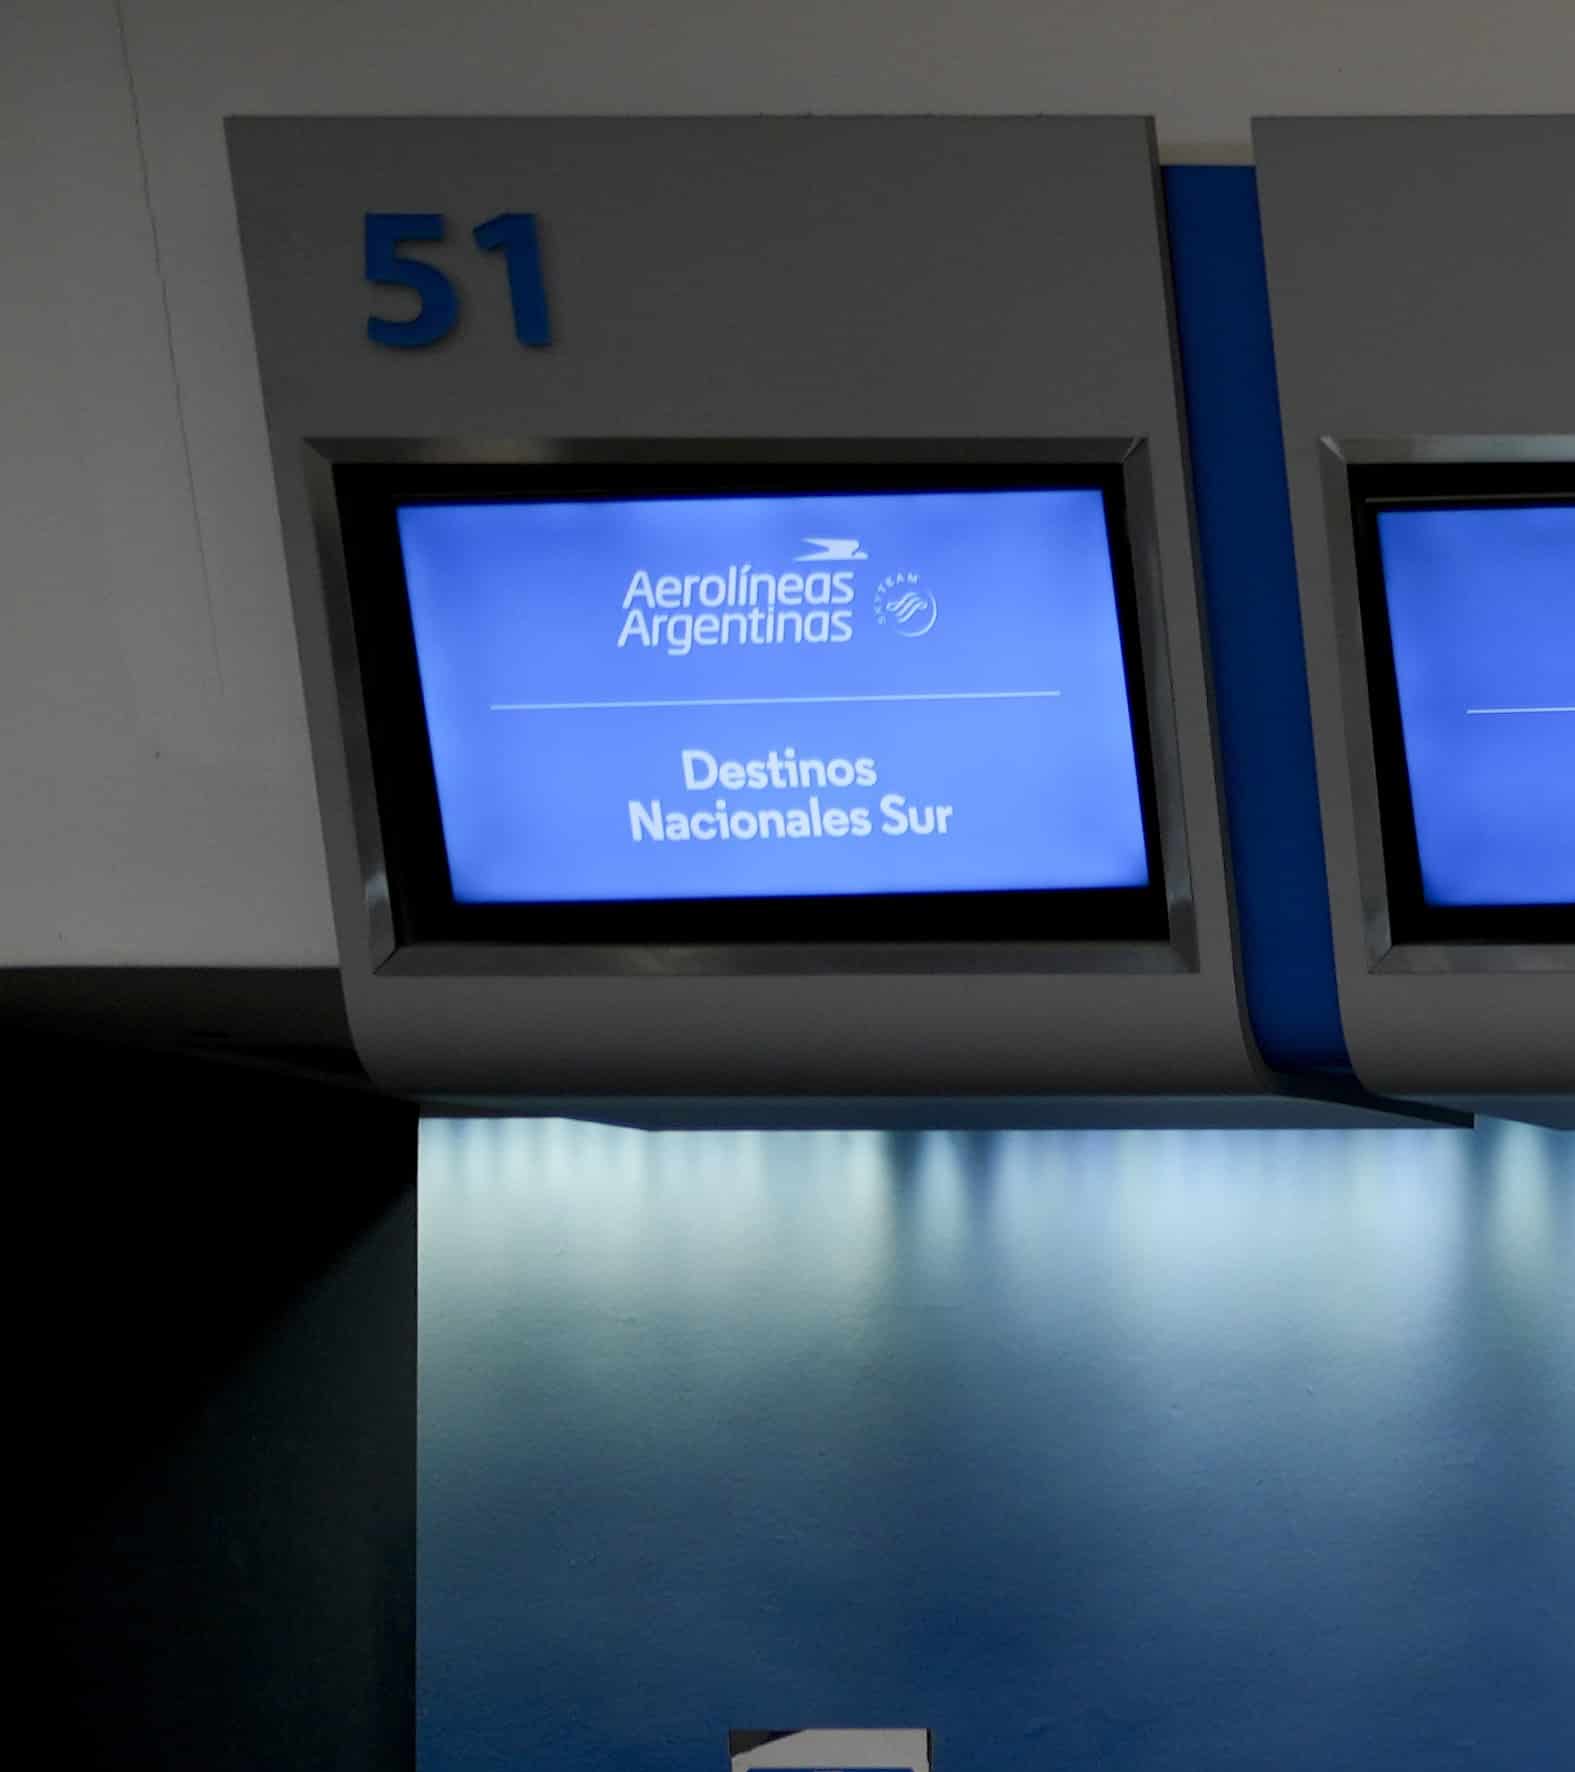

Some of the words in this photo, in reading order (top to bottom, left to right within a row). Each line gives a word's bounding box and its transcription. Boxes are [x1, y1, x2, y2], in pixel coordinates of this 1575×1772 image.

[363, 211, 555, 350] 51
[623, 564, 854, 608] Aerolíneas
[617, 603, 852, 656] Argentinas
[682, 747, 877, 790] Destinos
[628, 796, 871, 841] Nacionales
[880, 794, 952, 835] Sur
